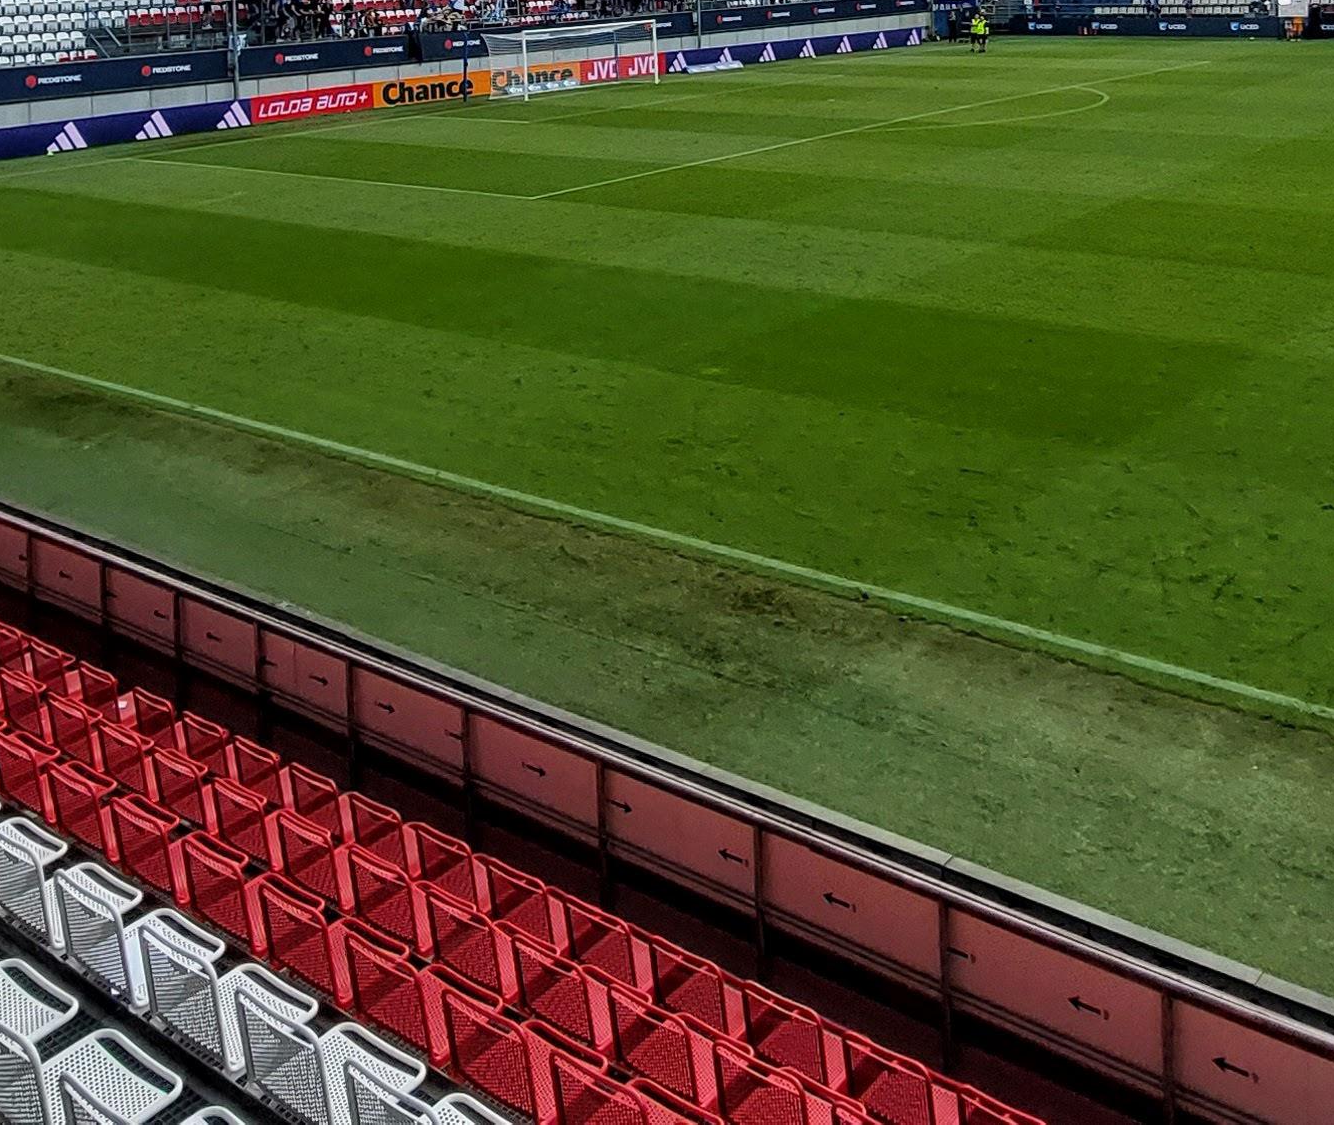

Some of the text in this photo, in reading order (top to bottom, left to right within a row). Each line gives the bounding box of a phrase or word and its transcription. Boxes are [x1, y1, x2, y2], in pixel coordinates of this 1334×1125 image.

[152, 64, 191, 74] REDSTONE
[587, 59, 617, 81] JVC
[38, 74, 82, 85] REDSTONE
[382, 78, 474, 106] Chance
